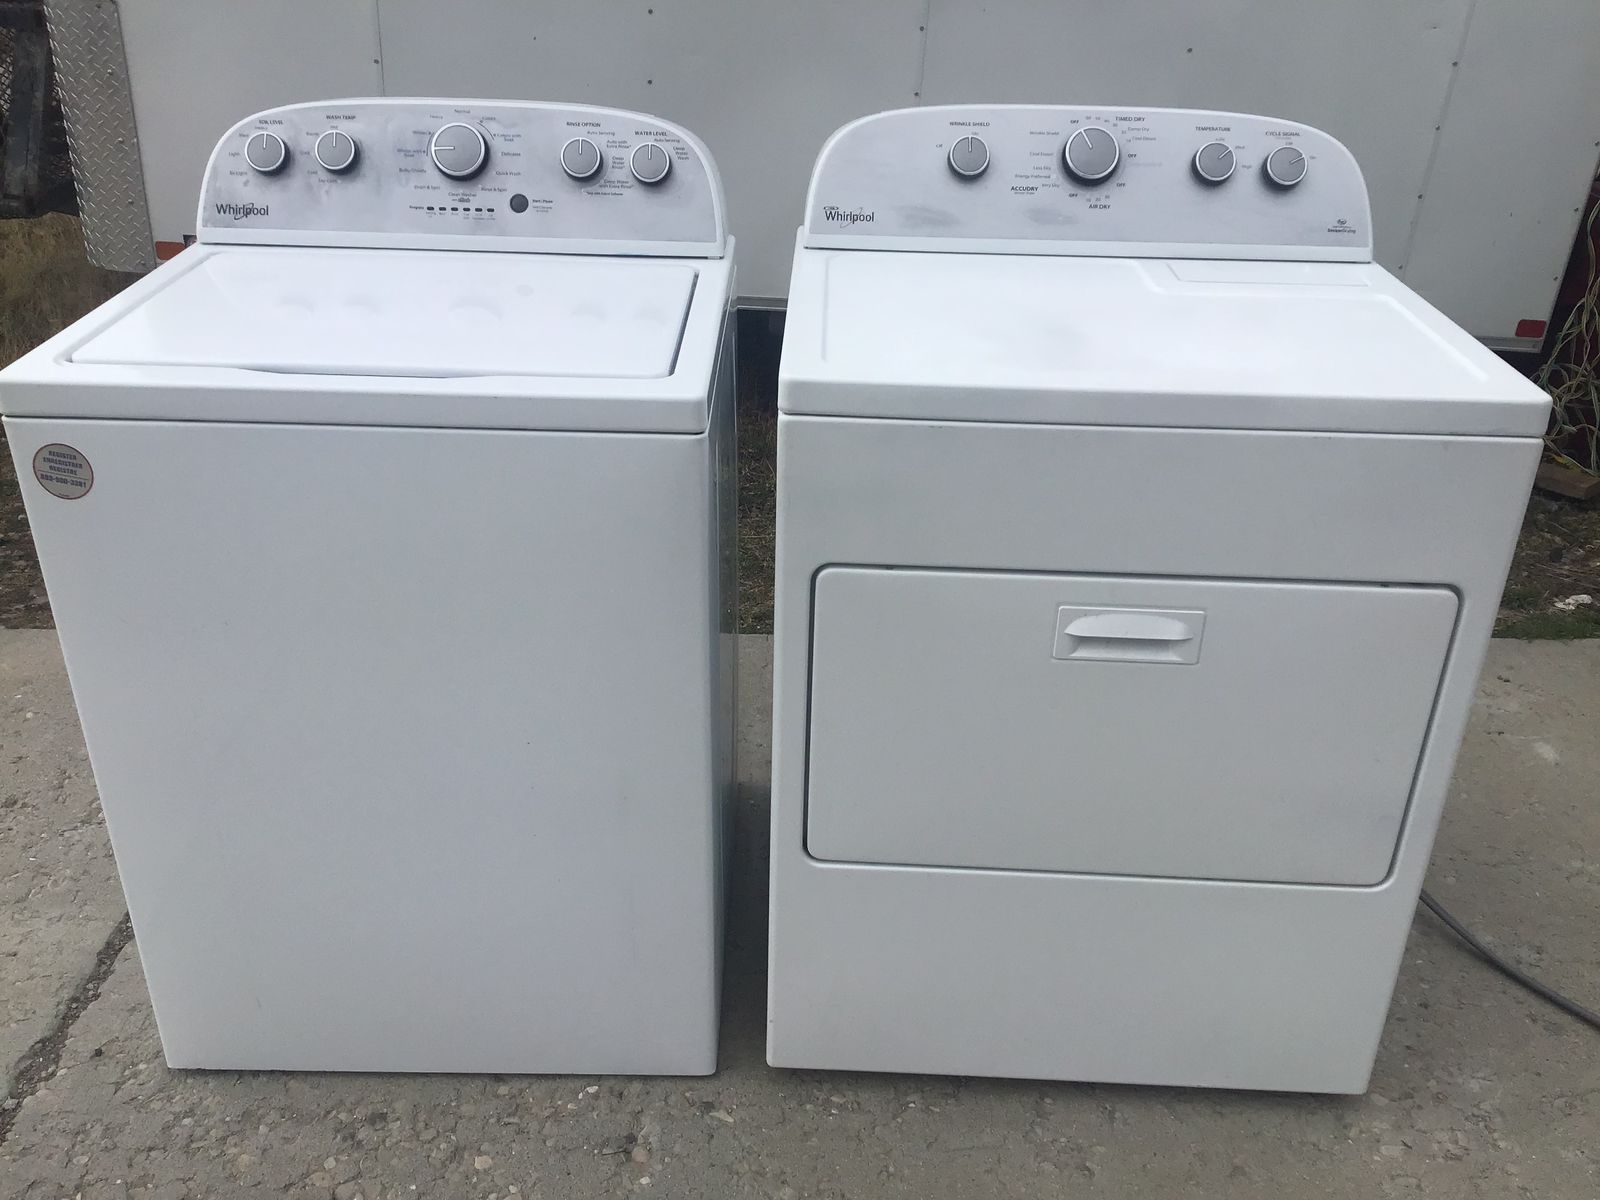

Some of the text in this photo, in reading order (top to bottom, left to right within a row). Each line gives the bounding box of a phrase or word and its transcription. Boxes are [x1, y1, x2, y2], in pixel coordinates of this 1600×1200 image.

[216, 204, 269, 218] Whirlpool
[825, 210, 874, 224] Whirlpool
[49, 450, 76, 460] REGISTER
